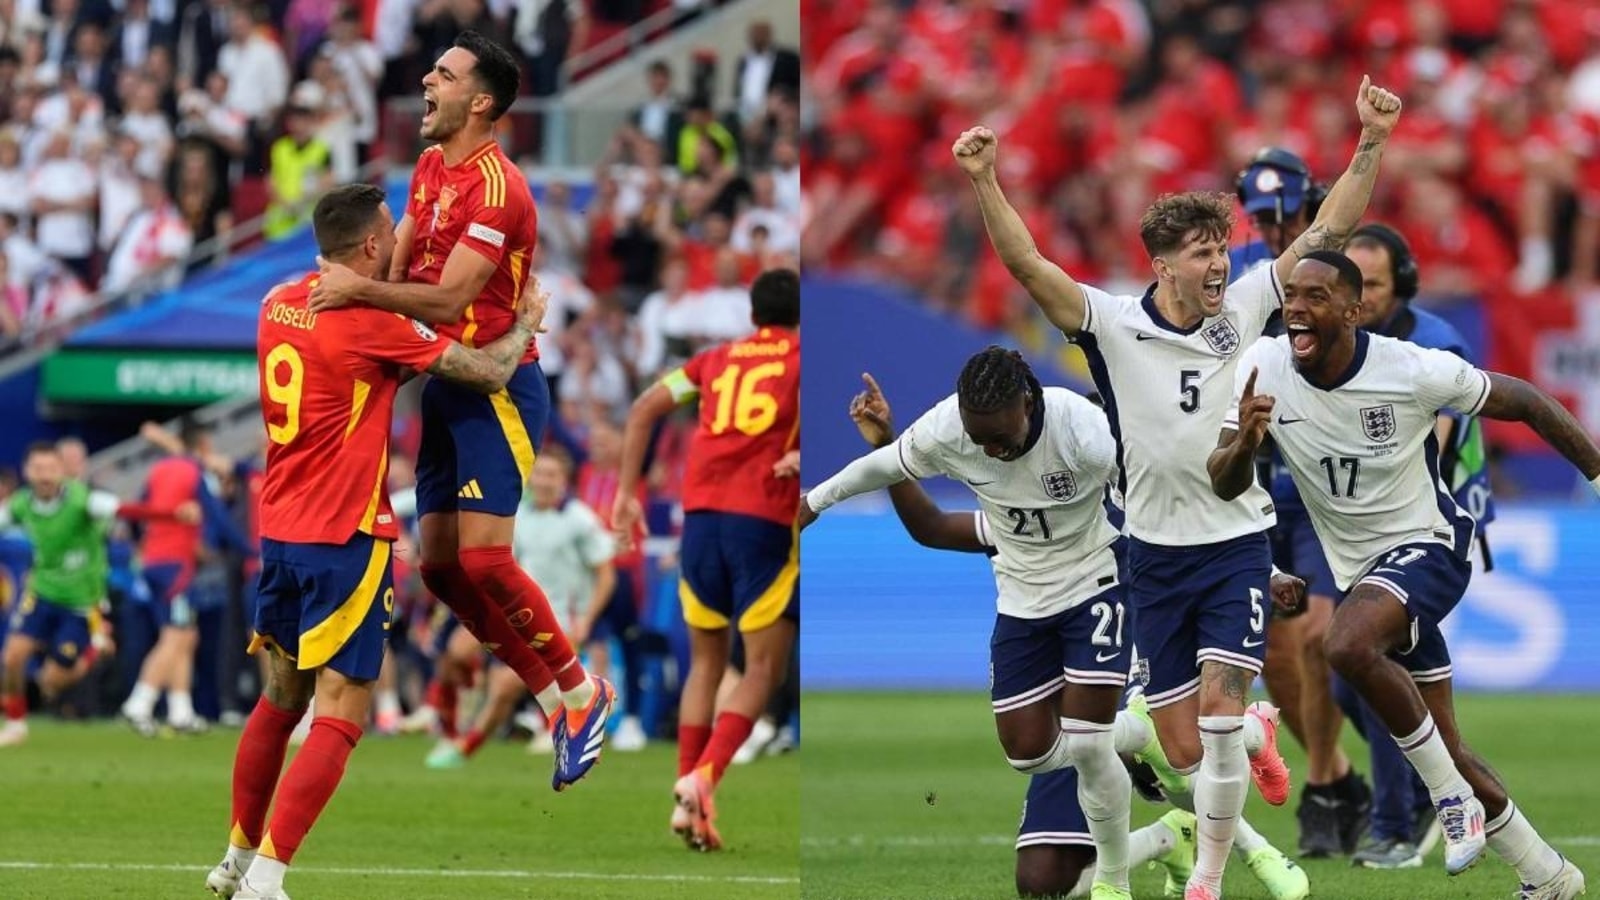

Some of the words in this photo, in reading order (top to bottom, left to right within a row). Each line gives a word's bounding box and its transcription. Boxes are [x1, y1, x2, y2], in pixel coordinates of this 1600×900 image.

[267, 301, 317, 330] JOSELU
[265, 342, 304, 445] 9
[711, 361, 785, 436] 16
[1180, 370, 1201, 413] 5
[1320, 456, 1361, 498] 17
[1007, 508, 1052, 541] 21
[1090, 601, 1125, 648] 21
[1249, 587, 1265, 634] 5
